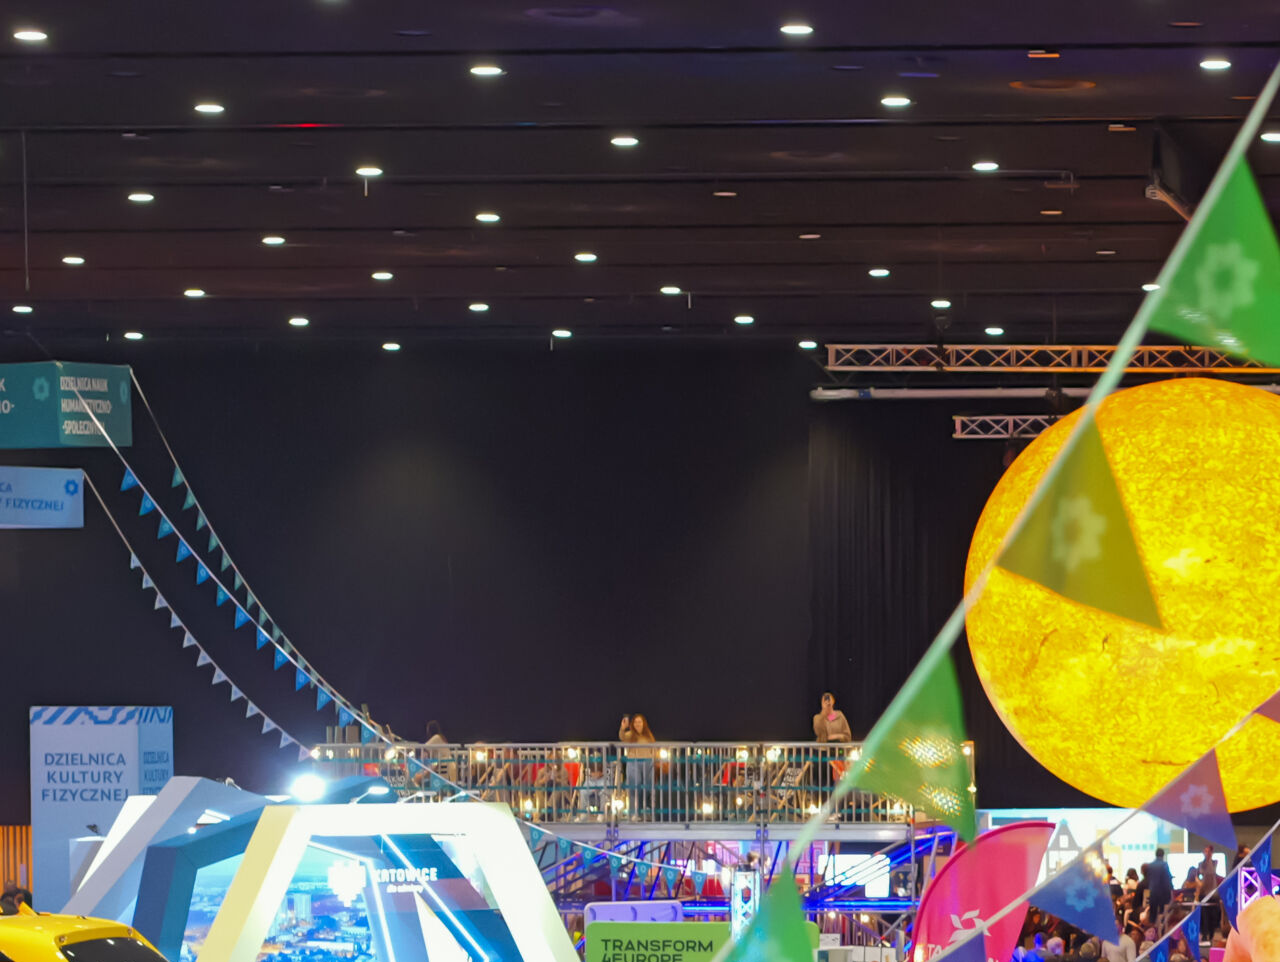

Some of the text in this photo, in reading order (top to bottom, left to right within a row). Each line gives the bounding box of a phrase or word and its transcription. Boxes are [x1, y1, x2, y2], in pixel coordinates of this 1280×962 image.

[44, 752, 126, 766] DZIELNICA
[47, 771, 124, 783] KULTURY
[41, 789, 129, 801] FIZYCZNEJ
[372, 867, 438, 882] KATOWICE
[601, 938, 713, 952] TRANSFORM
